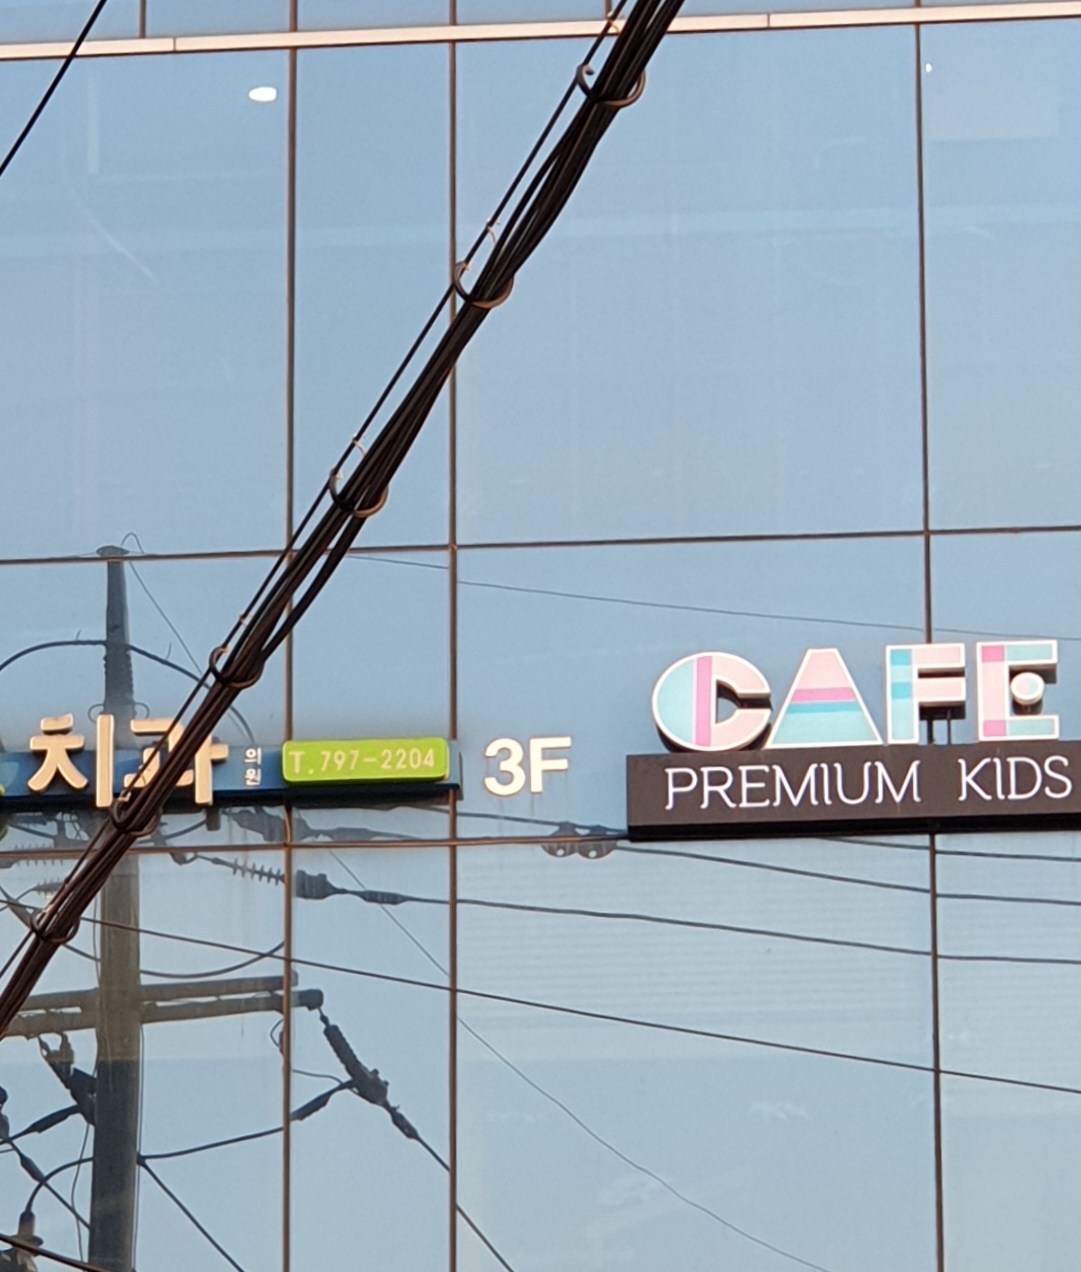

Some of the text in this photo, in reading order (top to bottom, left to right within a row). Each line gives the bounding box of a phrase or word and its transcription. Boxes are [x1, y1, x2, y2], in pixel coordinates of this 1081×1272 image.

[651, 640, 1060, 752] CAFE
[27, 713, 229, 808] 치과
[483, 736, 572, 797] 3F
[665, 755, 1073, 811] PREMIUM KIDS
